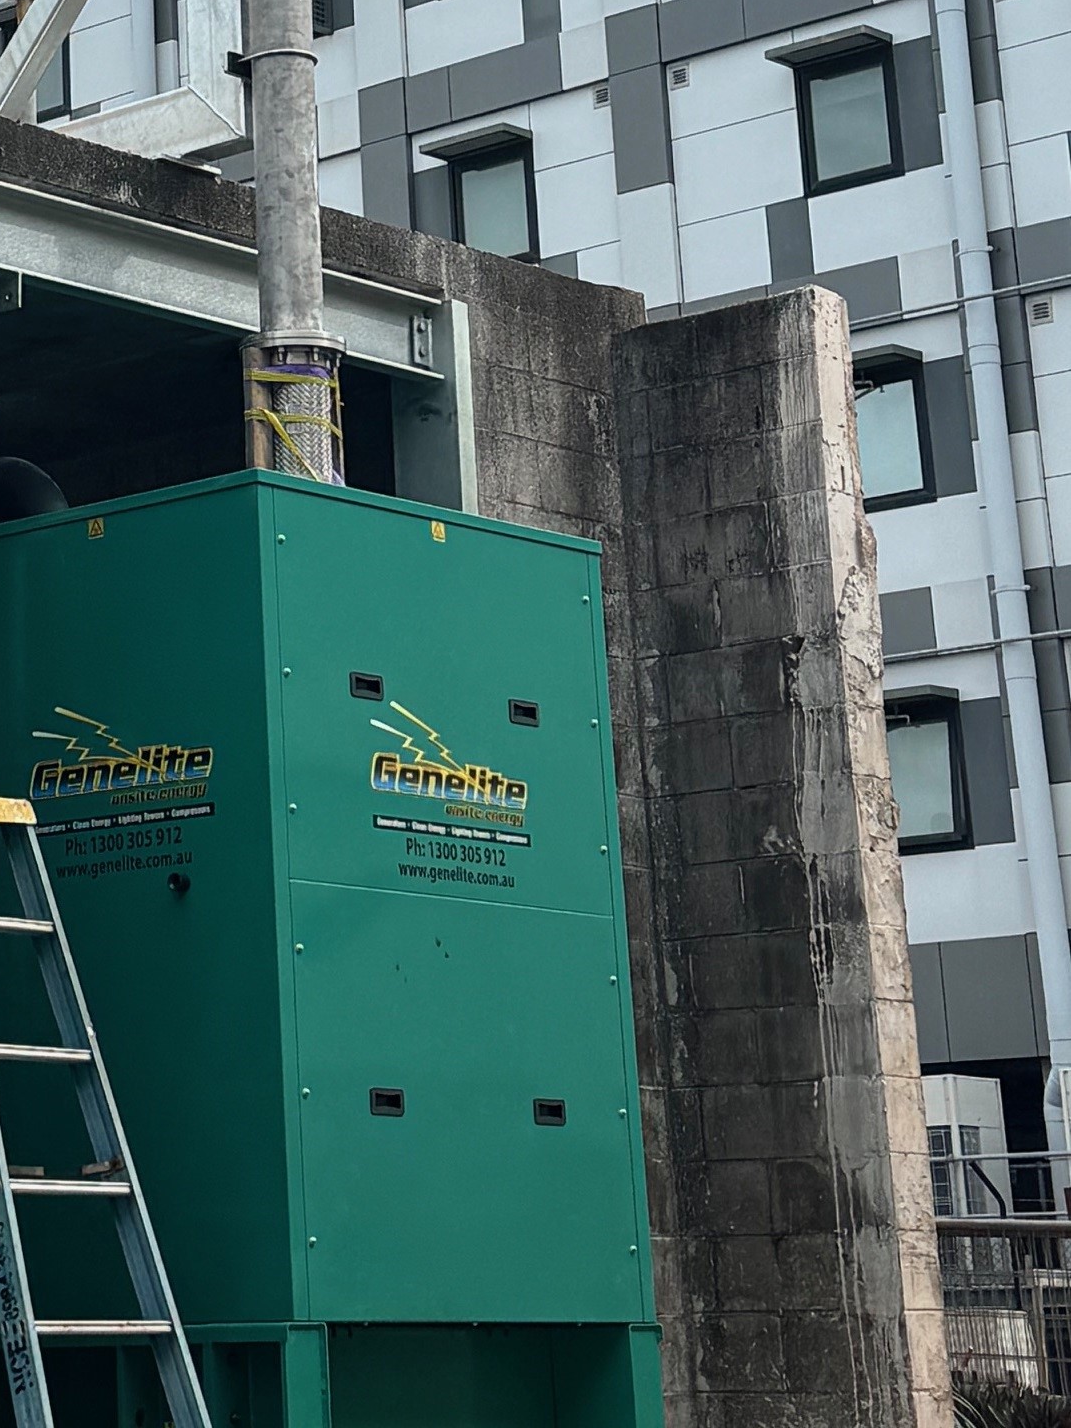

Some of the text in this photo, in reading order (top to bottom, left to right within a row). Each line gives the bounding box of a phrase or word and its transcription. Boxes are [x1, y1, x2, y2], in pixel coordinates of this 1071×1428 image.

[30, 743, 213, 800] Genelite
[370, 751, 528, 810] Genelite
[65, 826, 183, 857] Ph: 1300 305 912
[406, 838, 507, 867] Ph: 1300 305 912
[55, 851, 193, 879] www.genelite.com.au
[398, 862, 515, 888] www.genelite.com.au
